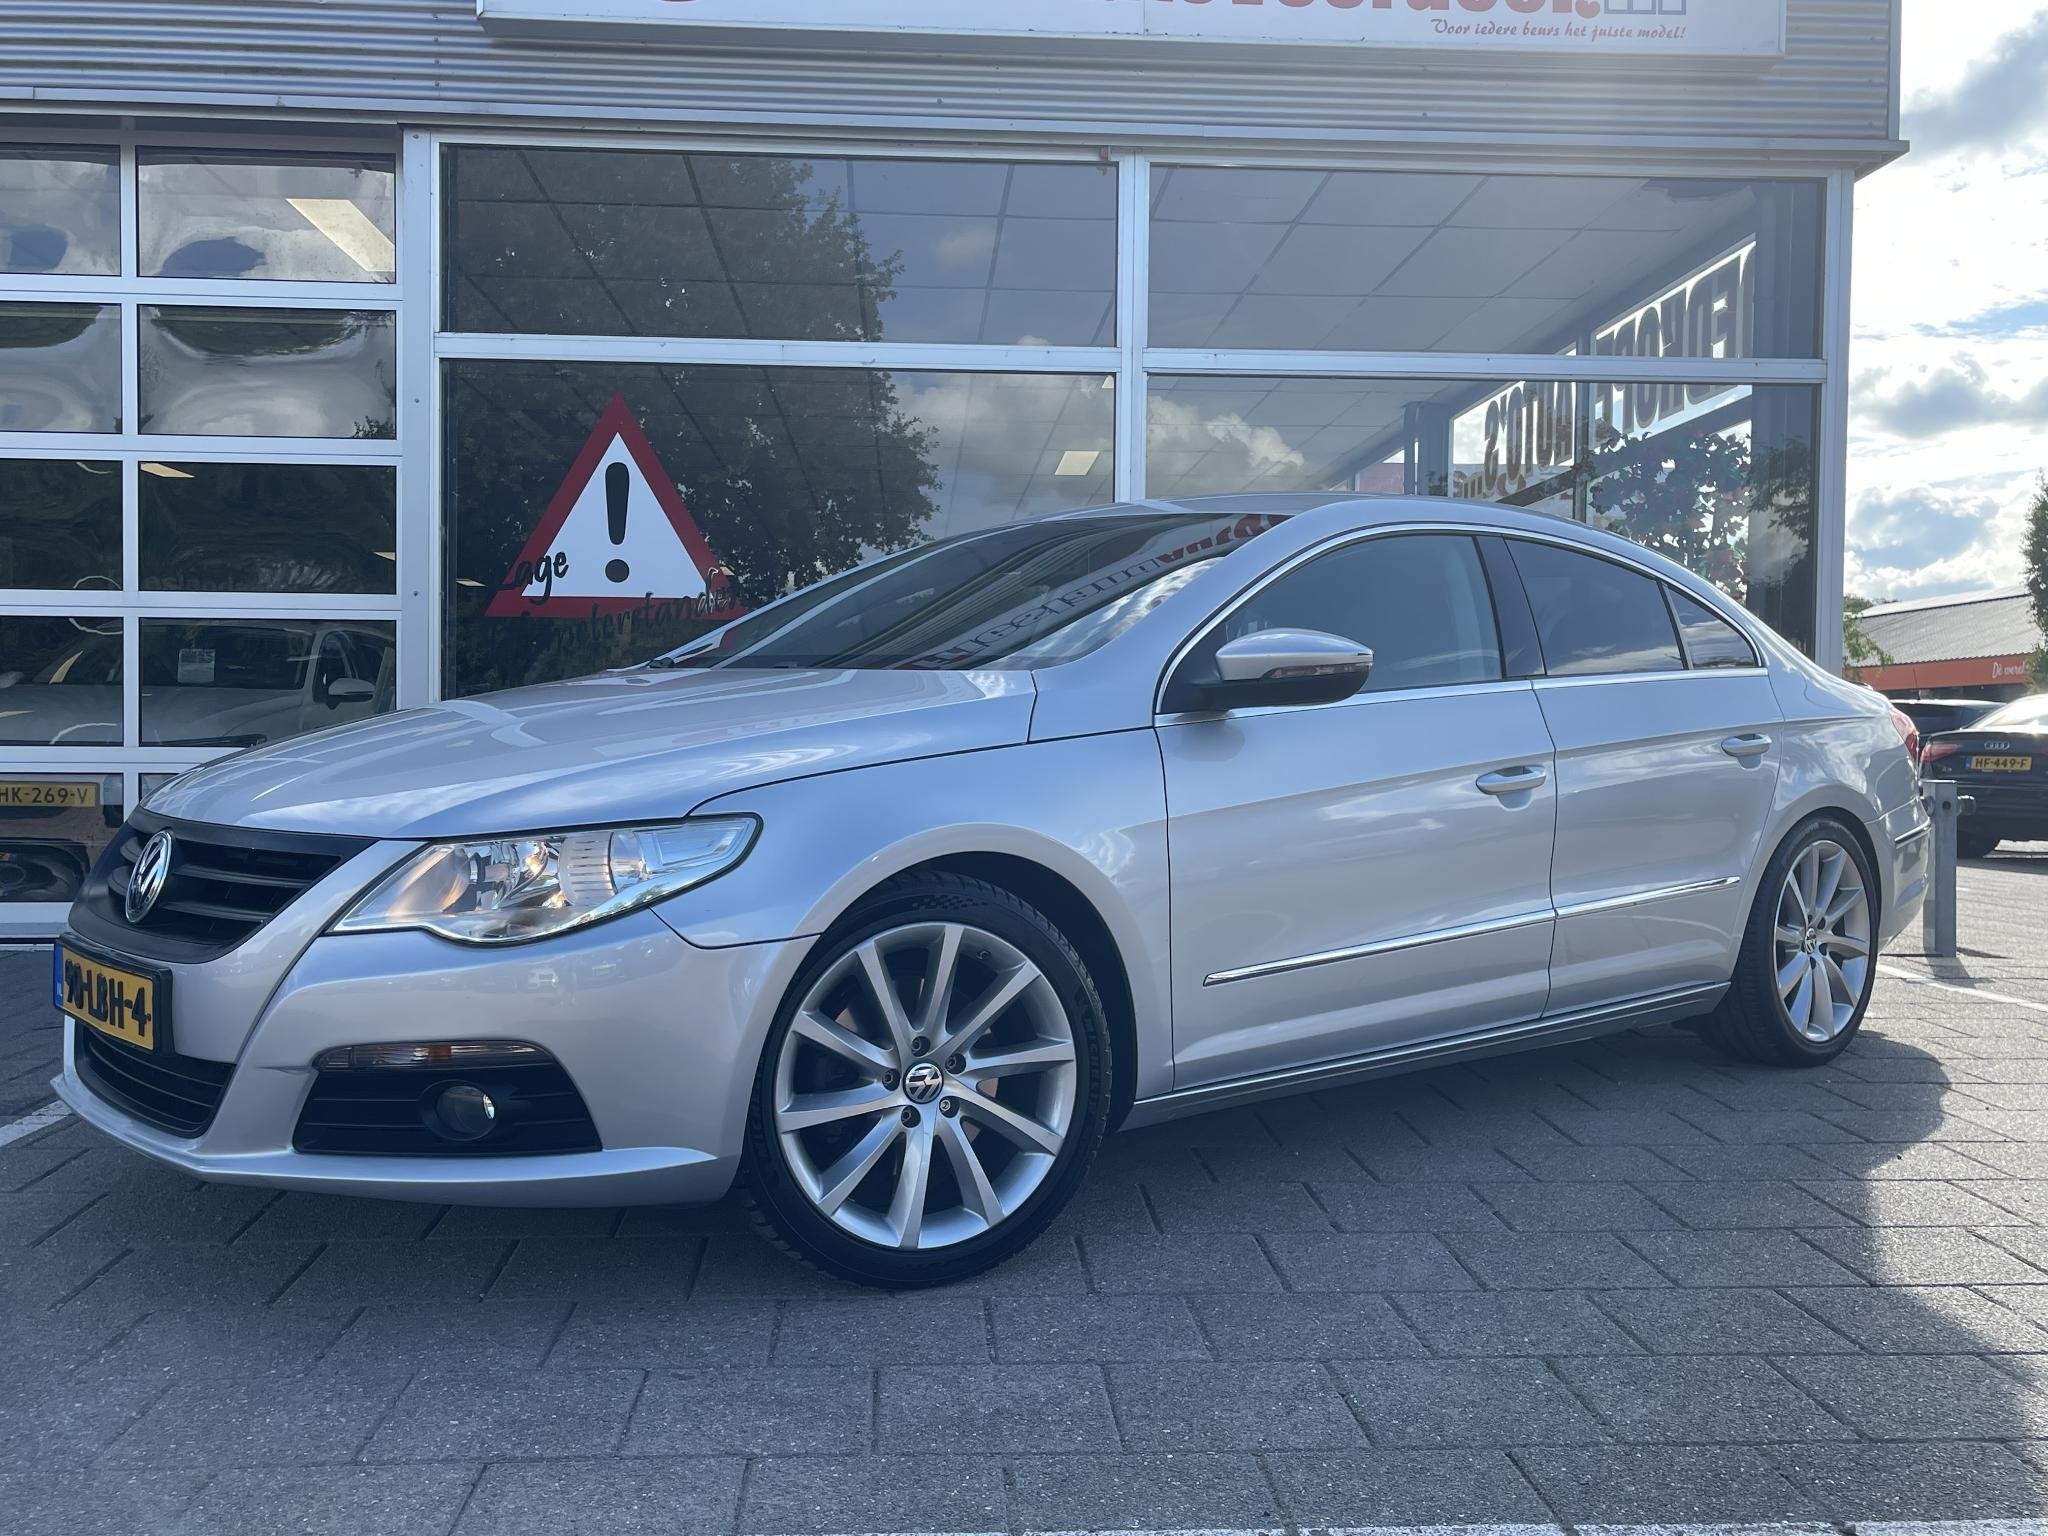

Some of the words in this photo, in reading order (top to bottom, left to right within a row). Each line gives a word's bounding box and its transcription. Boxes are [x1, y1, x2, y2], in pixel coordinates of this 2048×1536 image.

[1431, 18, 1470, 35] Voor
[1474, 20, 1518, 36] iedere
[1522, 20, 1560, 37] beurs
[1564, 21, 1587, 37] het
[1591, 25, 1633, 42] juiste
[1637, 24, 1686, 39] model!
[1975, 756, 2028, 768] HF-449-F
[0, 786, 88, 804] HK-269-V
